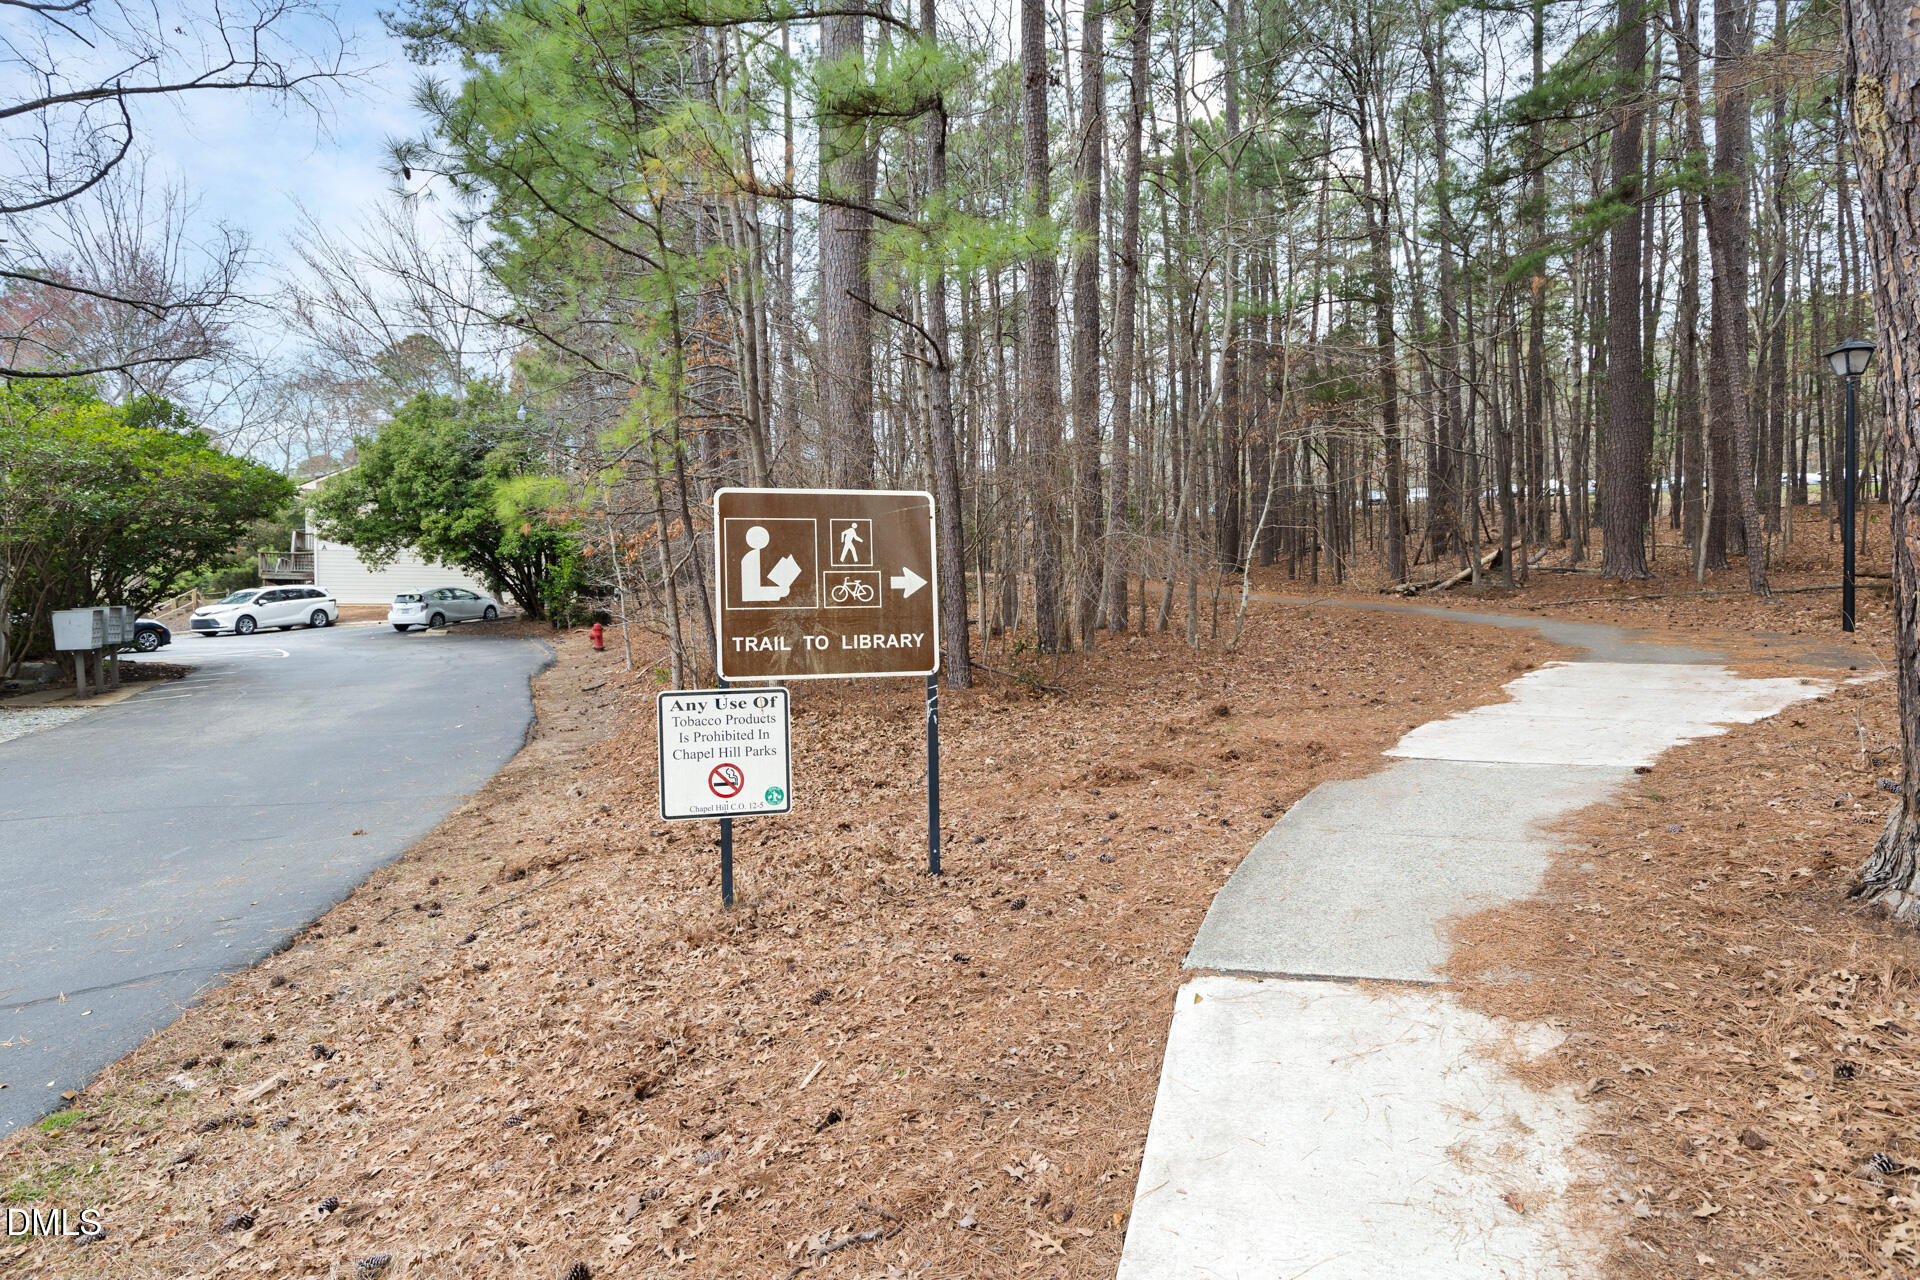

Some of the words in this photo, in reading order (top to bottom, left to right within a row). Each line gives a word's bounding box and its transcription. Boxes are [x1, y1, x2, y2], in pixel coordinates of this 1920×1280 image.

[732, 636, 791, 652] TRAIL
[803, 635, 829, 650] TO
[843, 633, 924, 649] LIBRARY
[670, 700, 707, 713] Any
[715, 698, 747, 710] Use
[753, 696, 778, 709] Of
[672, 716, 722, 727] Tobacco
[726, 714, 776, 725] Products
[679, 732, 689, 743] Is
[694, 730, 754, 742] Prohibited
[758, 729, 770, 740] In
[673, 748, 714, 761] Chapel
[719, 746, 740, 758] Hill
[745, 745, 777, 756] Parks
[689, 802, 714, 813] Chapel
[715, 802, 729, 811] Hill
